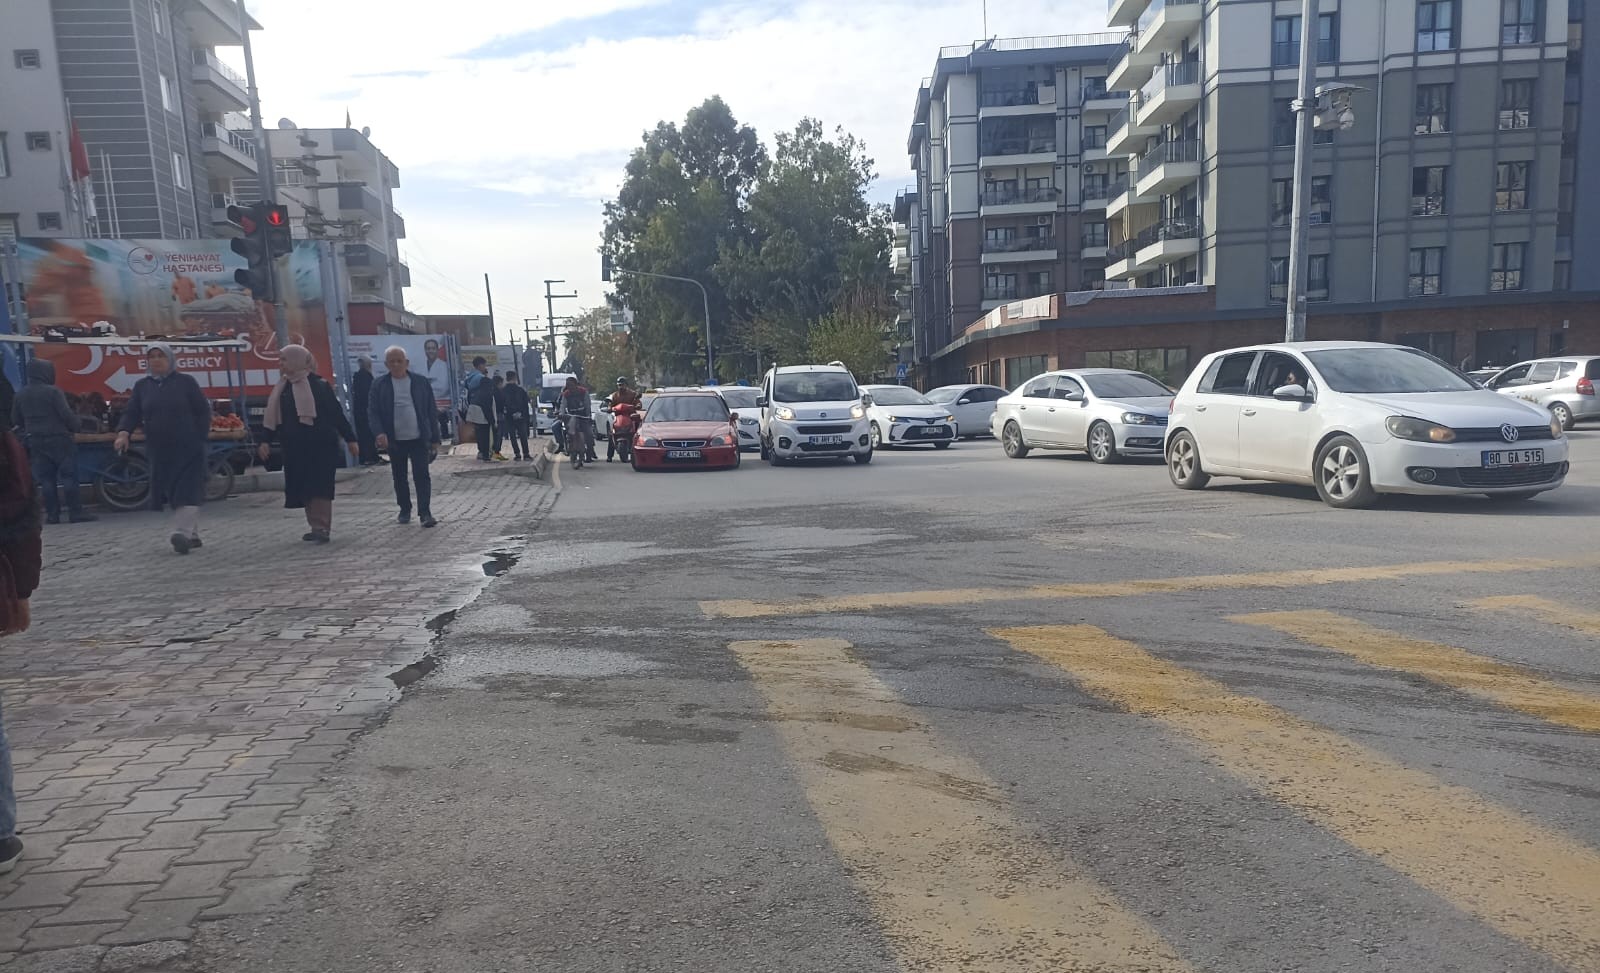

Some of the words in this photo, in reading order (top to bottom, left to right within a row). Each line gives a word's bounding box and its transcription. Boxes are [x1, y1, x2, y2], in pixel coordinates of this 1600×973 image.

[137, 356, 222, 370] EGENCY
[1489, 453, 1501, 464] 80
[1508, 452, 1520, 463] GA
[1524, 450, 1541, 462] 515
